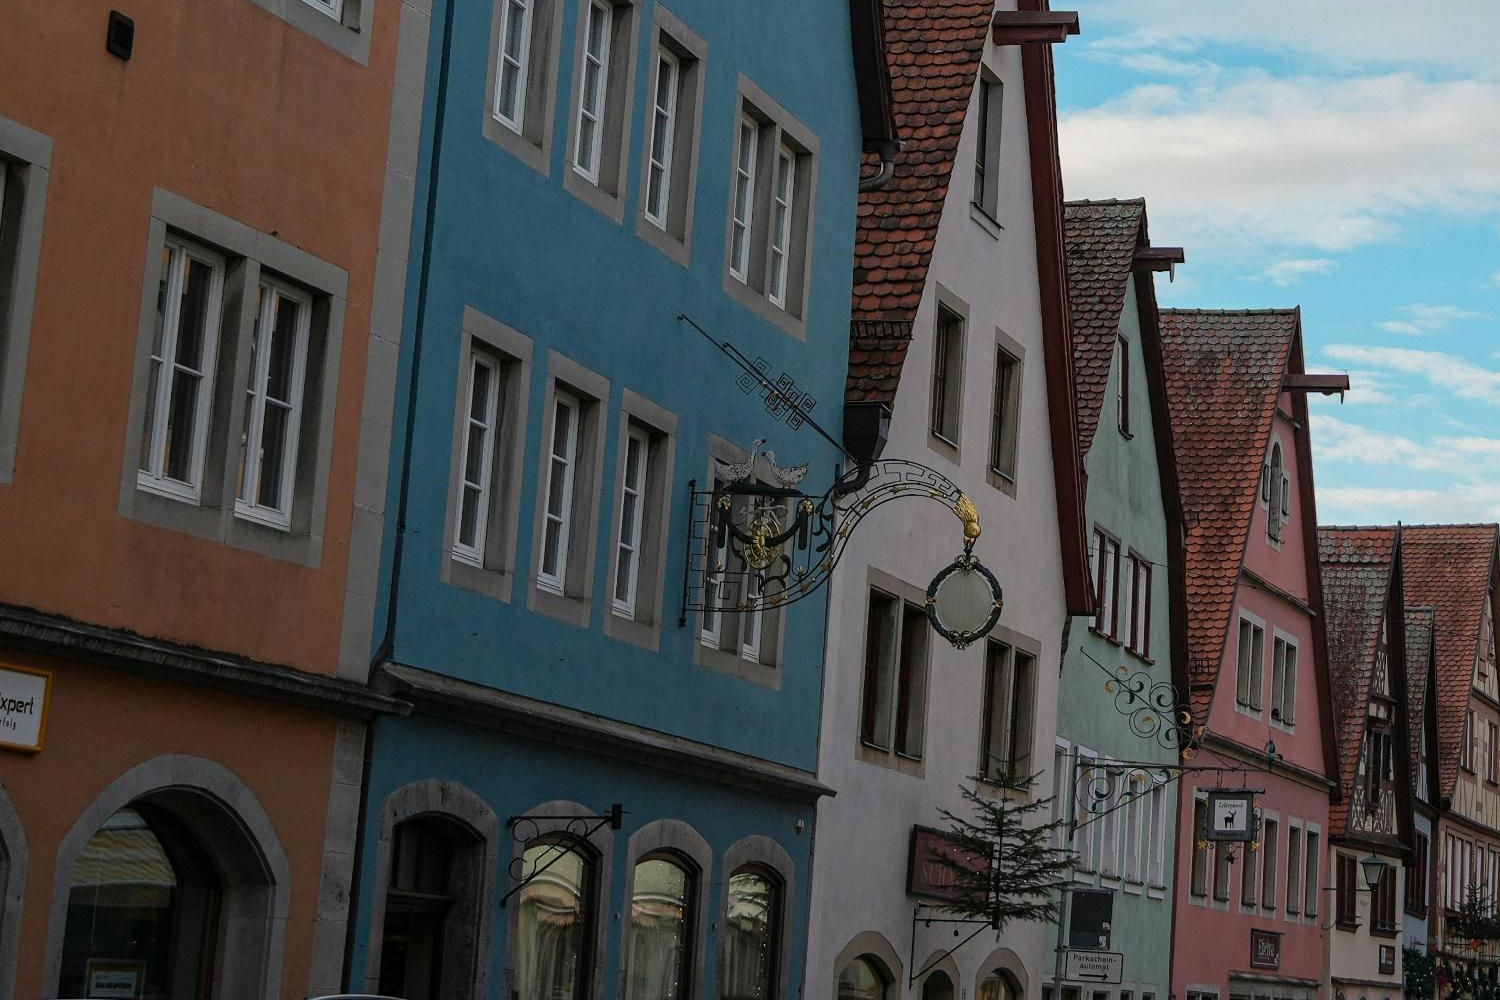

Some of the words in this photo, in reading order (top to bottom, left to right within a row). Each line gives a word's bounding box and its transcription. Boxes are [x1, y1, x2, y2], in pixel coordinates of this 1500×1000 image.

[0, 696, 34, 715] xpert
[1073, 953, 1117, 964] Parkschein-
[1079, 963, 1110, 971] automat
